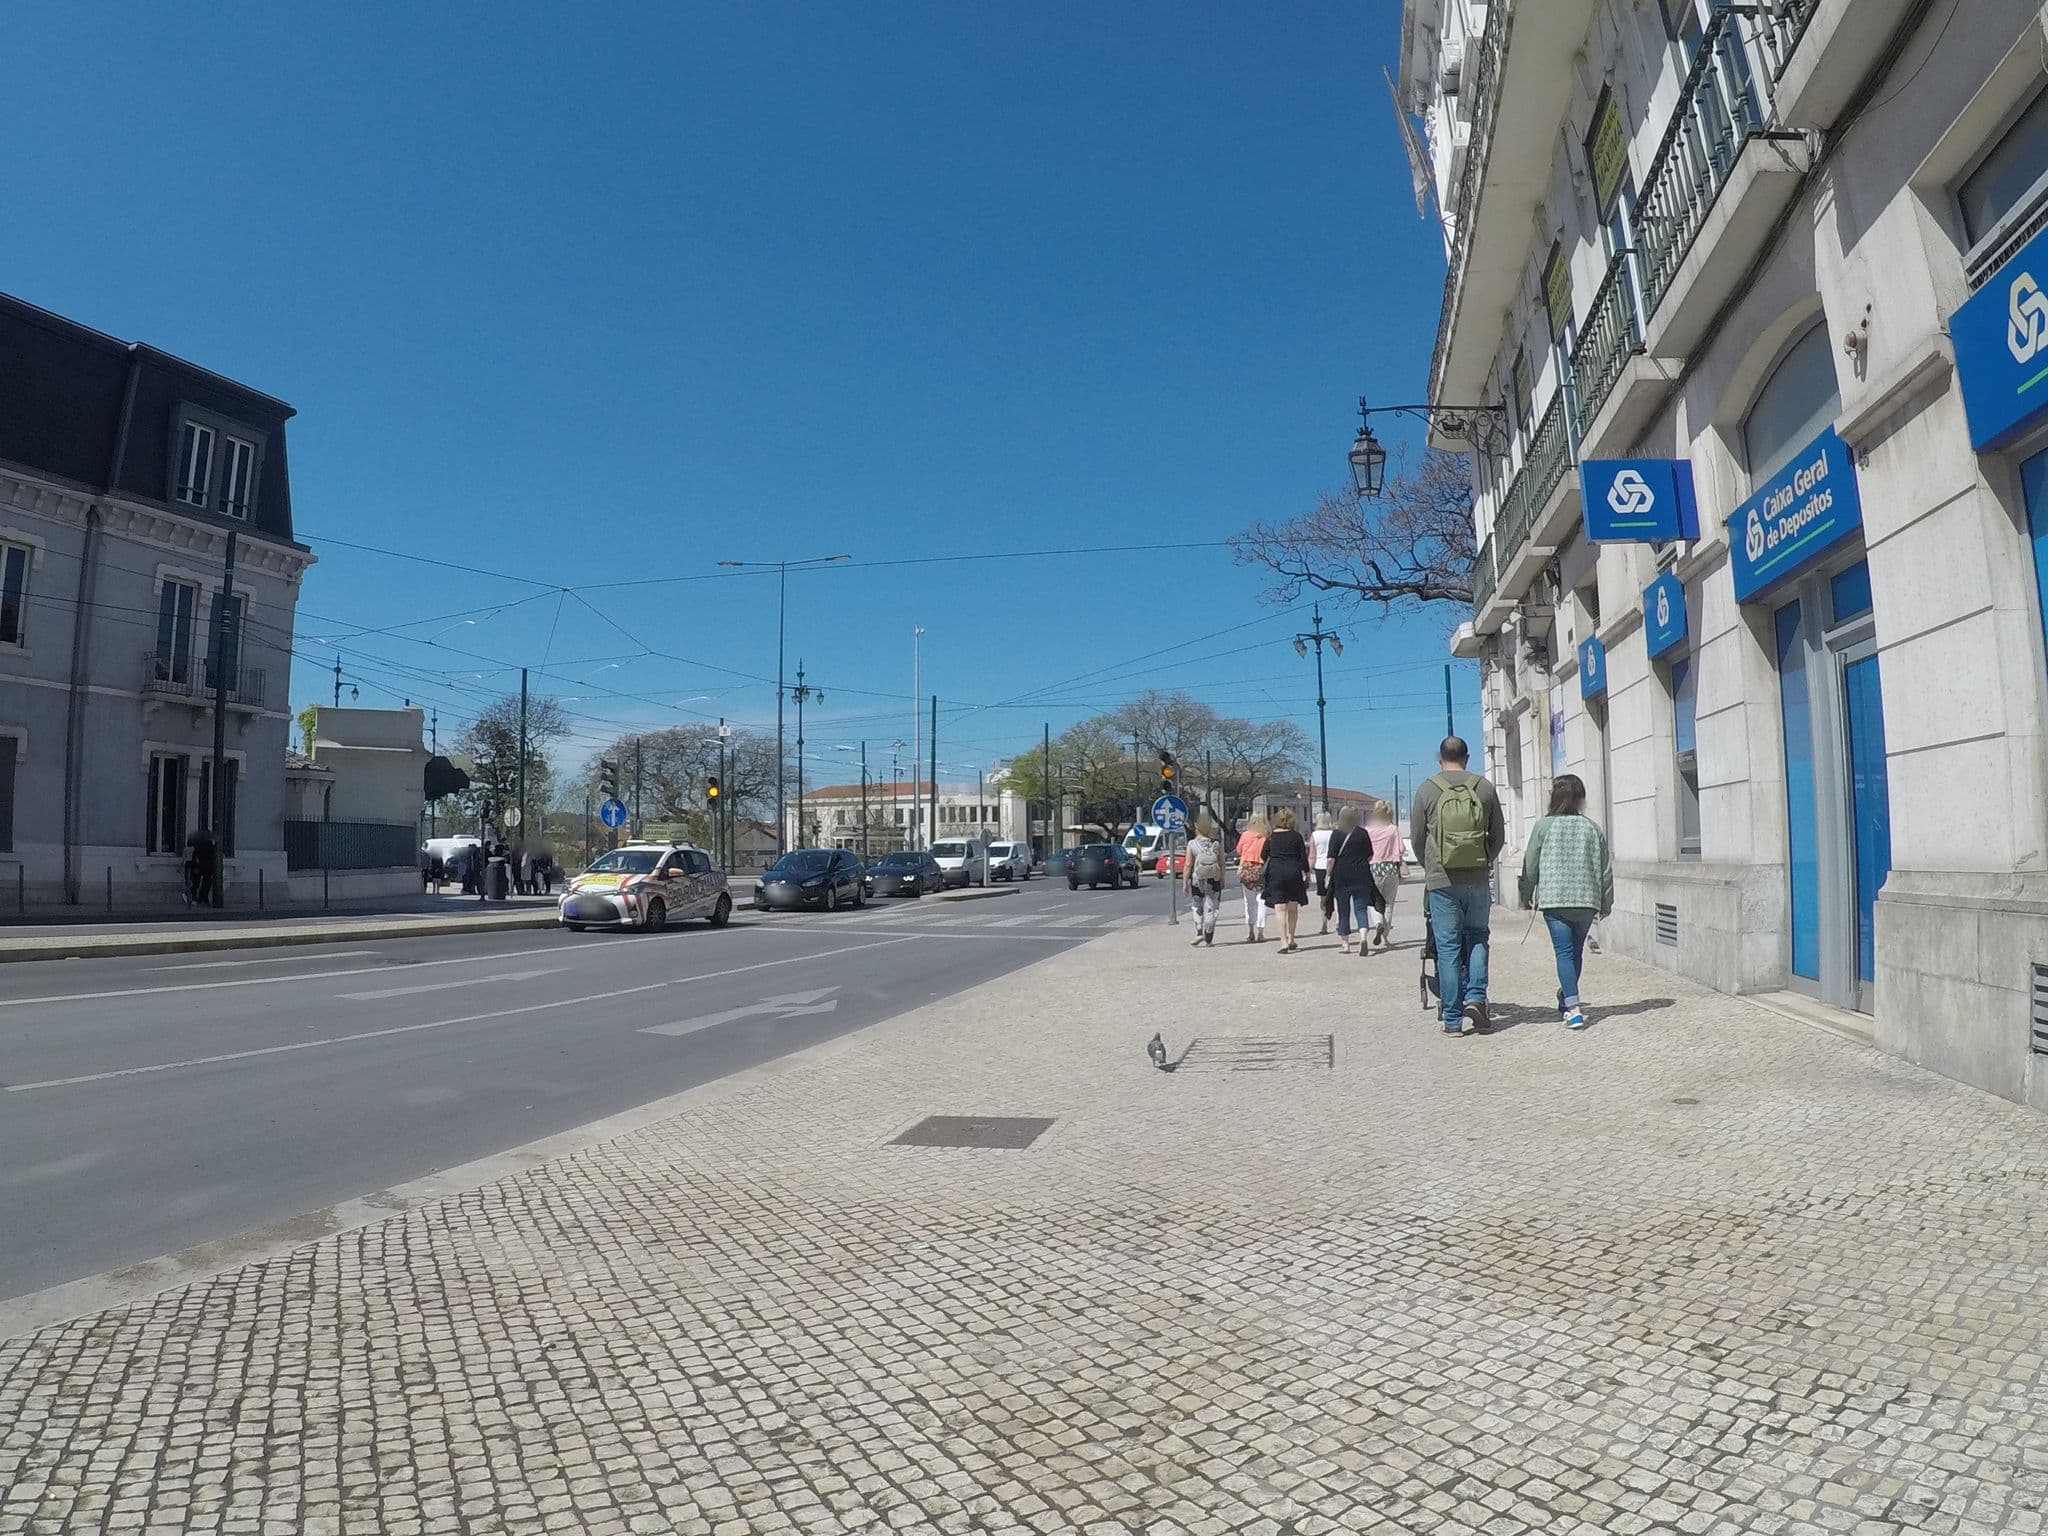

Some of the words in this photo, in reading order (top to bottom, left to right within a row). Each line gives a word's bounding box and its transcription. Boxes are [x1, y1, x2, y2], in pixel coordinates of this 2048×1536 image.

[1763, 485, 1794, 521] Caixa
[1794, 449, 1829, 496] Geral
[1767, 526, 1779, 549] de
